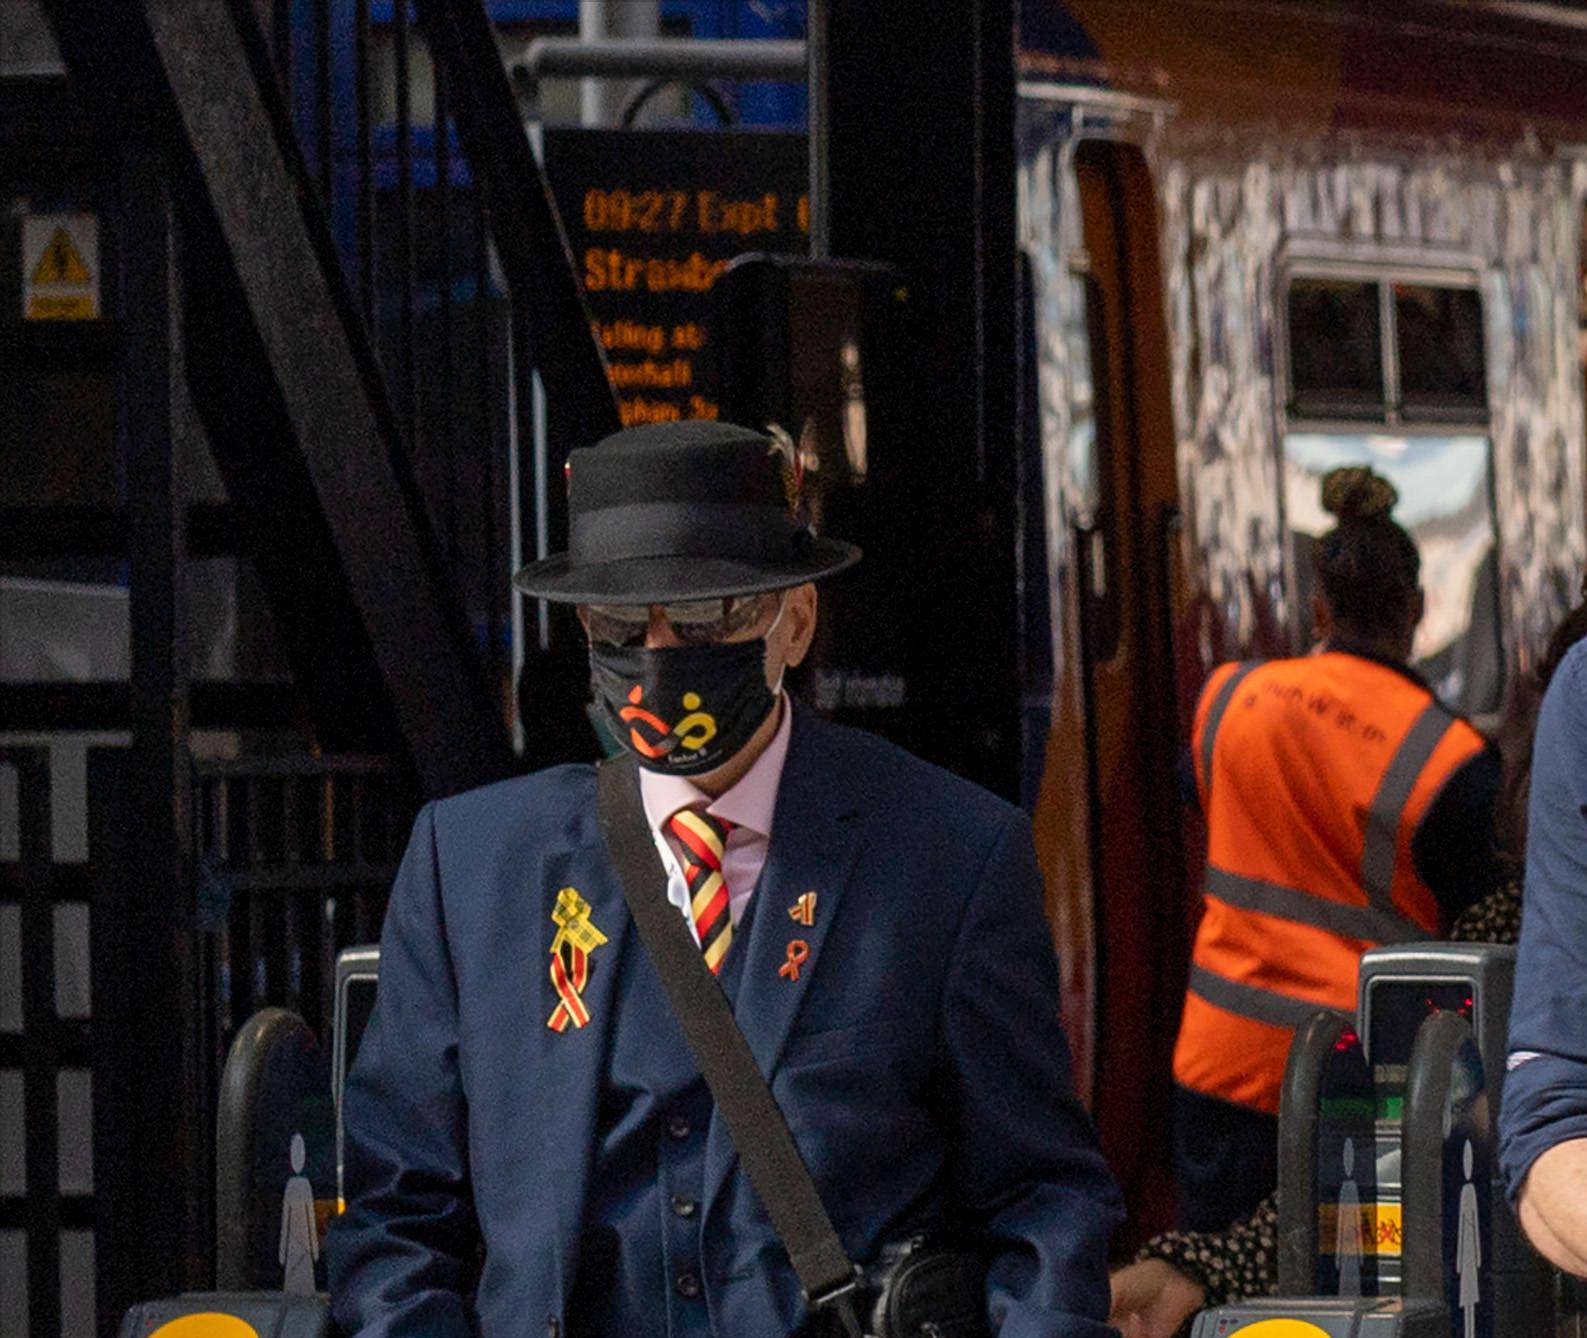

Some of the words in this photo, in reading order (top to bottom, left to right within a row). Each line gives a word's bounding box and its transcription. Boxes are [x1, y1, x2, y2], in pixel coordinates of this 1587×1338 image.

[583, 188, 688, 232] 09:27
[697, 190, 778, 234] Expt
[600, 319, 665, 354] alling
